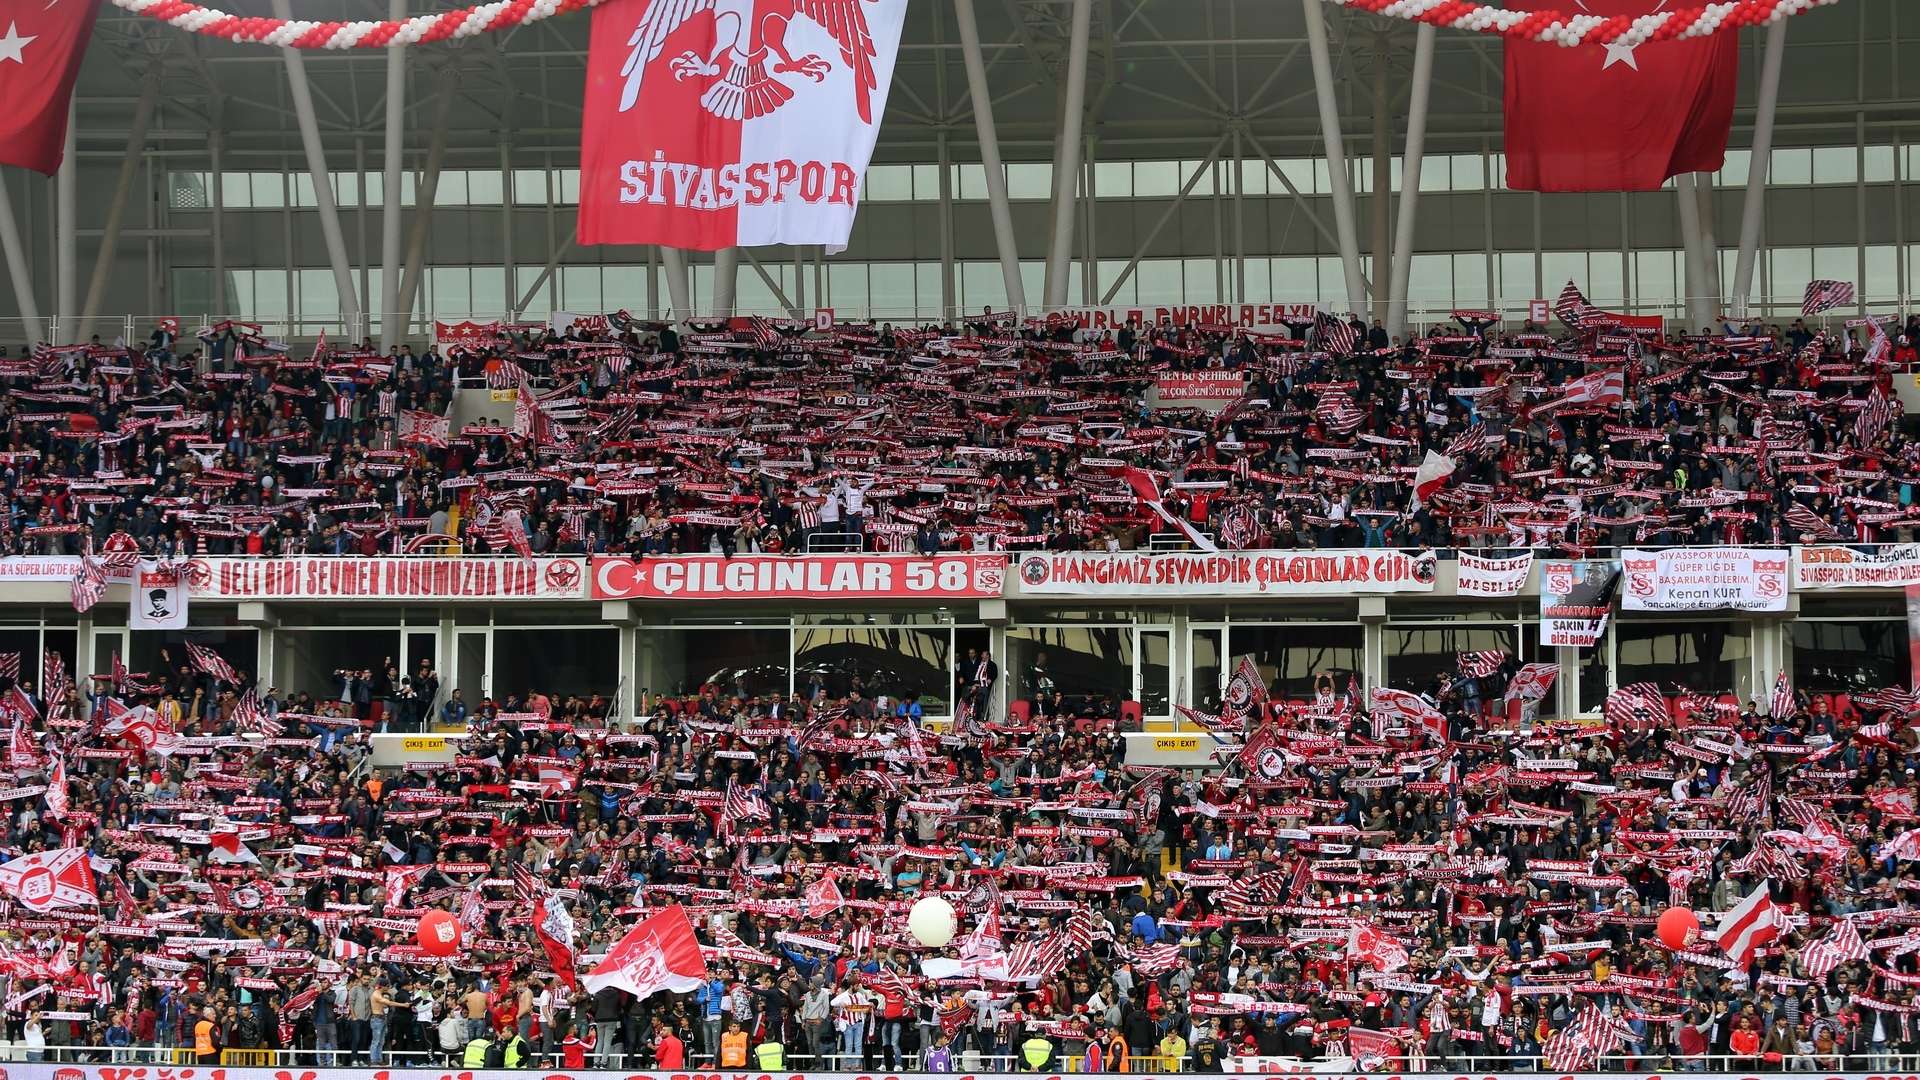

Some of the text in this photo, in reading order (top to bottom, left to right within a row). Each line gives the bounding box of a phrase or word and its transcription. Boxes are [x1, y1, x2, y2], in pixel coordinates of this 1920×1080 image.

[619, 150, 857, 210] SİVASSPOR
[817, 312, 832, 329] D
[1160, 371, 1179, 380] BEN
[1170, 388, 1187, 398] ÇOK
[1188, 384, 1208, 396] SENİ
[1209, 384, 1241, 396] SEVDİM
[1660, 551, 1750, 560] SİVASSPOR'UMUZA
[16, 562, 40, 575] SÜPER
[1459, 556, 1531, 571] MEMLEKET
[1674, 562, 1703, 572] SÜPER
[220, 561, 259, 595] DELİ
[264, 561, 301, 595] GİBİ
[386, 560, 497, 596] RUHUMUZDA
[503, 561, 537, 596] VAR
[652, 560, 968, 595] ÇILGINLAR 58
[1052, 552, 1409, 592] HANGİMİZ SEVMEDİK ÇILGINLAR GİBİ
[1801, 567, 1844, 582] SİVASSPOR
[1659, 574, 1711, 585] BAŞARILAR
[1668, 588, 1742, 599] Kenan KURT
[1643, 600, 1768, 609] Sancaktepe Emniyet Müdürü
[1553, 620, 1584, 631] SAKIN
[1551, 631, 1568, 644] BİZİ
[1156, 740, 1176, 748] ÇIKIŞ
